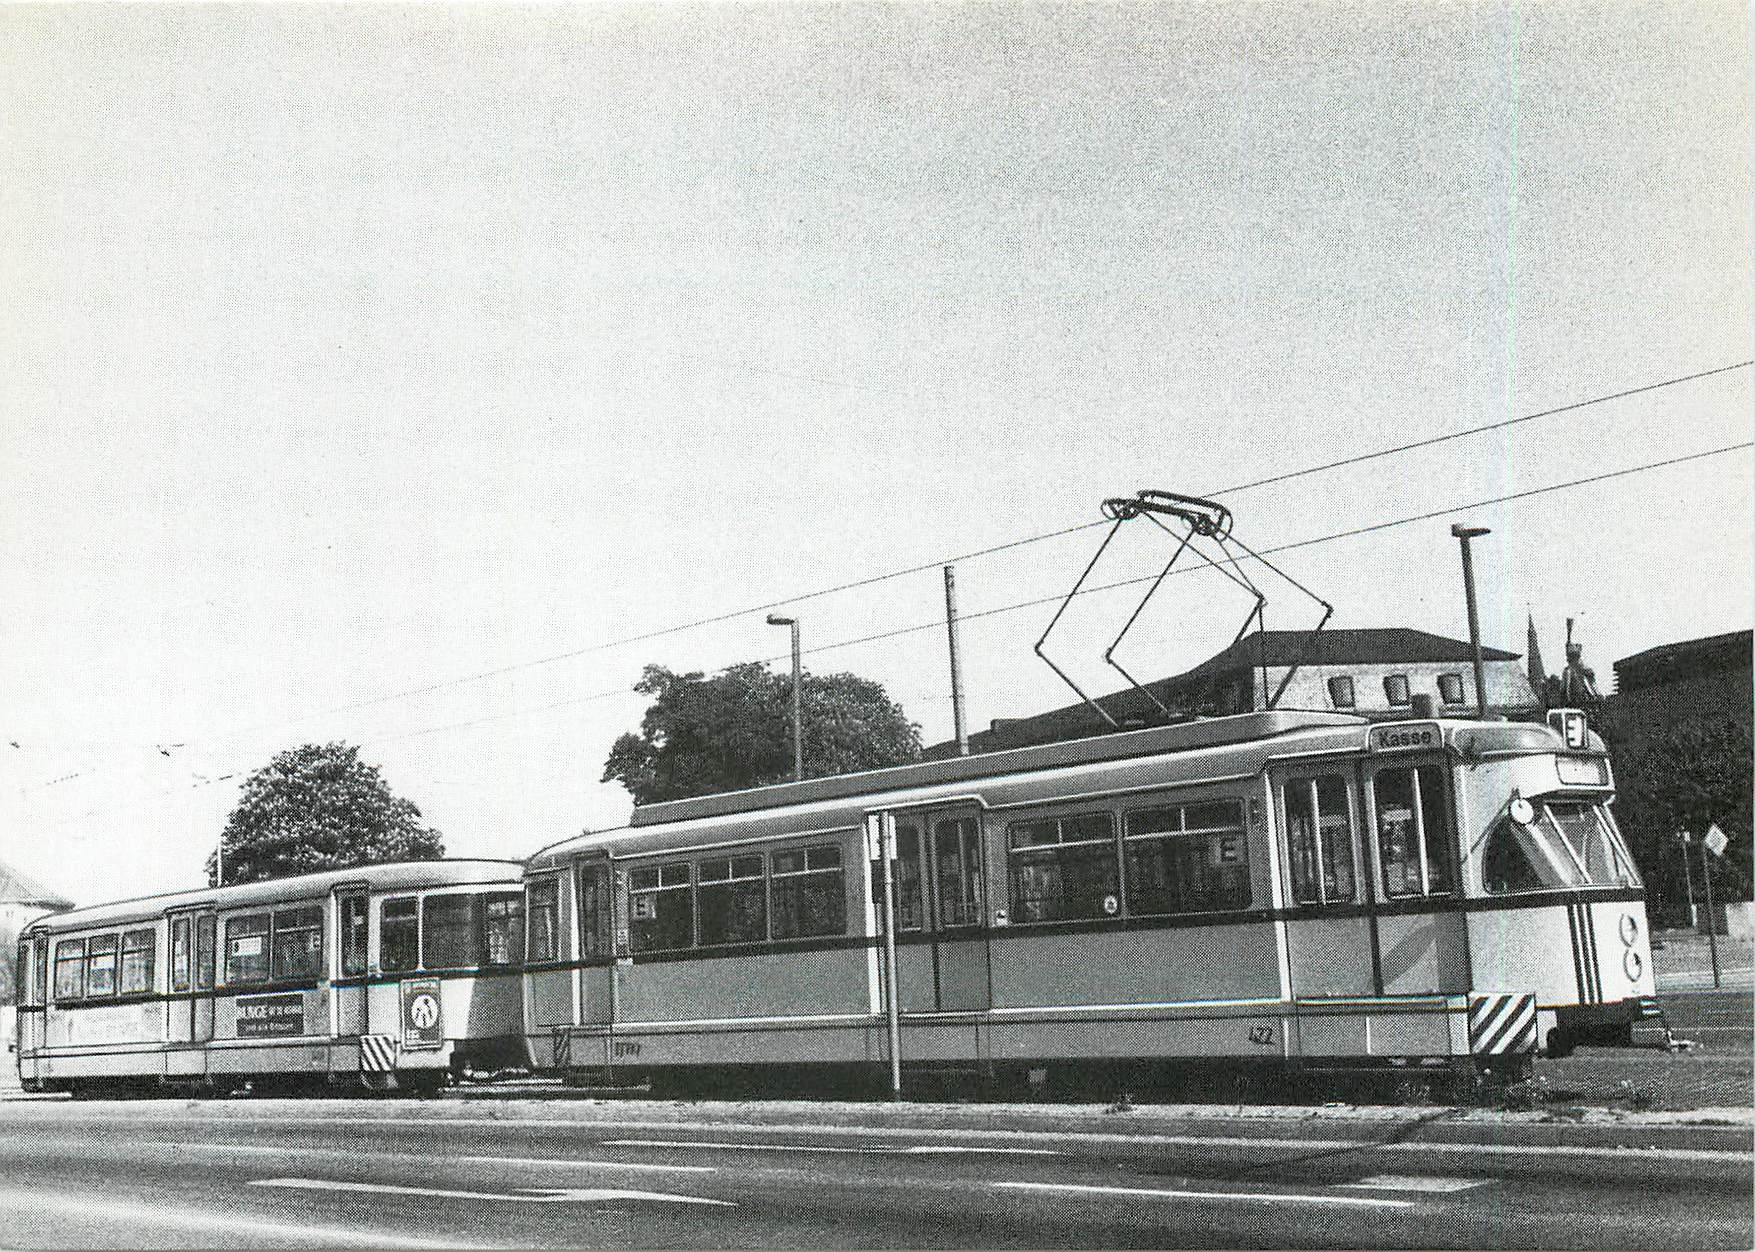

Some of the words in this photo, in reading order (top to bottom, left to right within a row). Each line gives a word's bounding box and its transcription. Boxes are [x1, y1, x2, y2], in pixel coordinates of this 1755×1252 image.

[1379, 730, 1432, 748] Kasse
[1220, 836, 1237, 862] E
[636, 896, 646, 916] E
